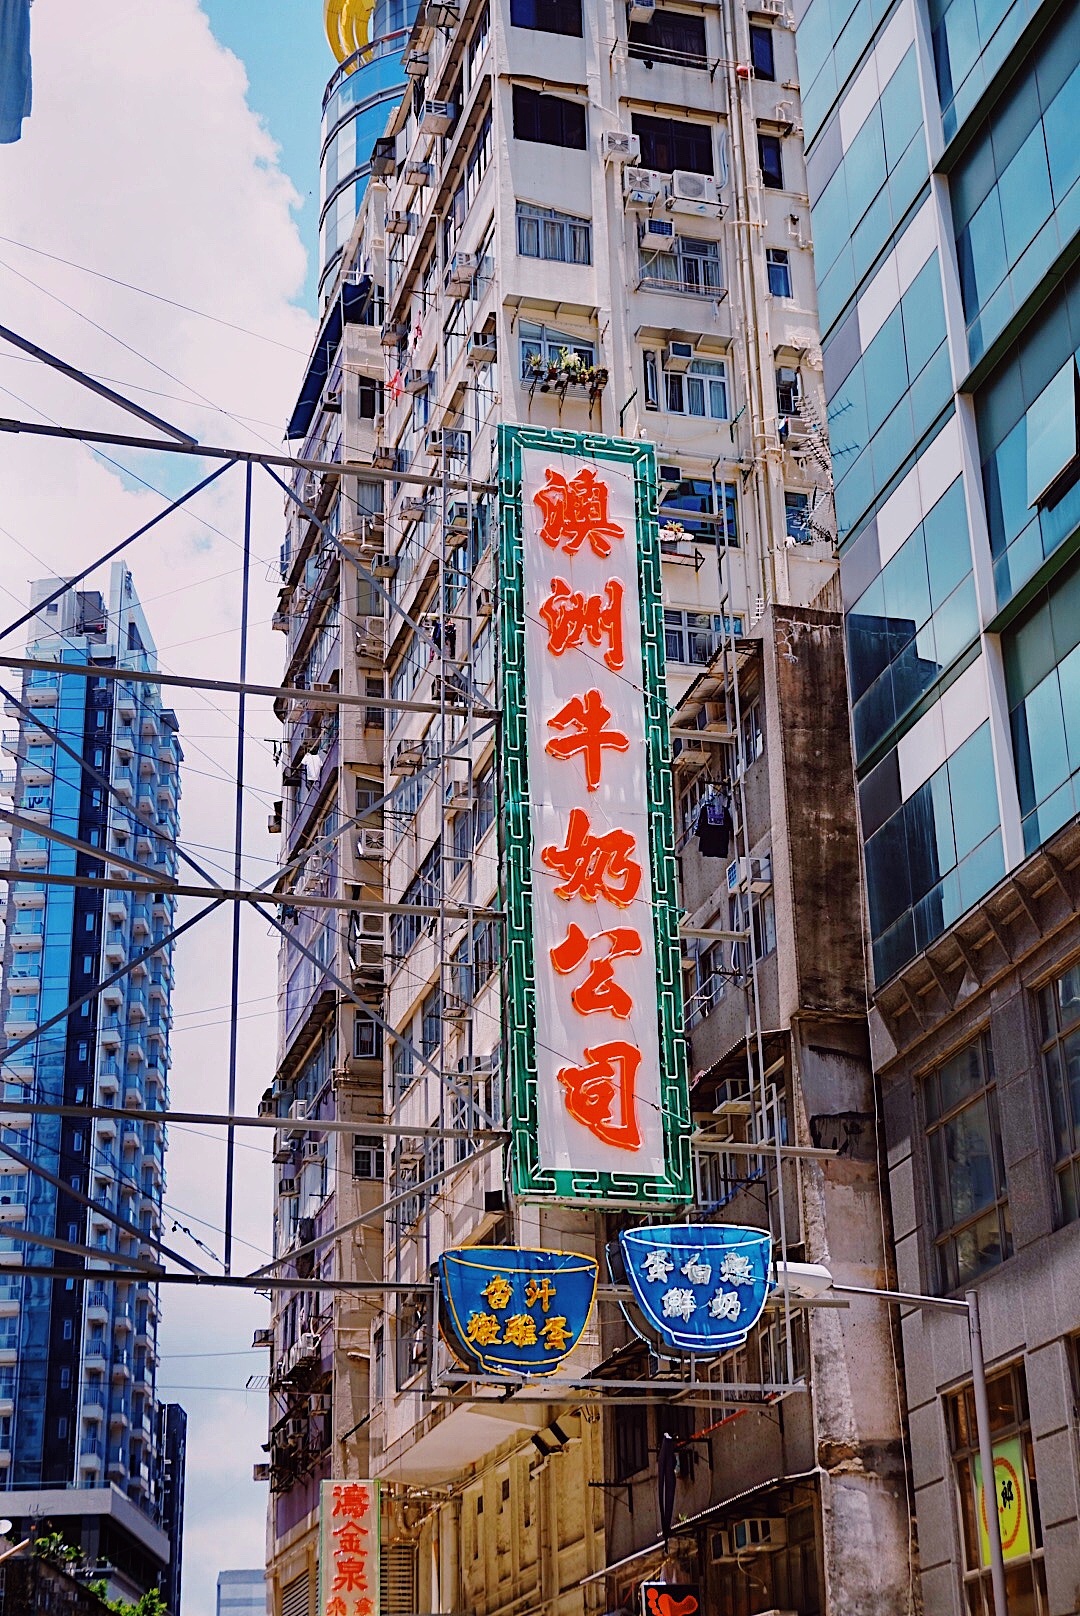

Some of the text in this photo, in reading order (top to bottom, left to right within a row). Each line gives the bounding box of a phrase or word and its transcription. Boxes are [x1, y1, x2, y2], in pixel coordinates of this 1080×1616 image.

[533, 464, 643, 1153] 澳洲牛奶公司
[661, 1287, 741, 1323] 鮮奶
